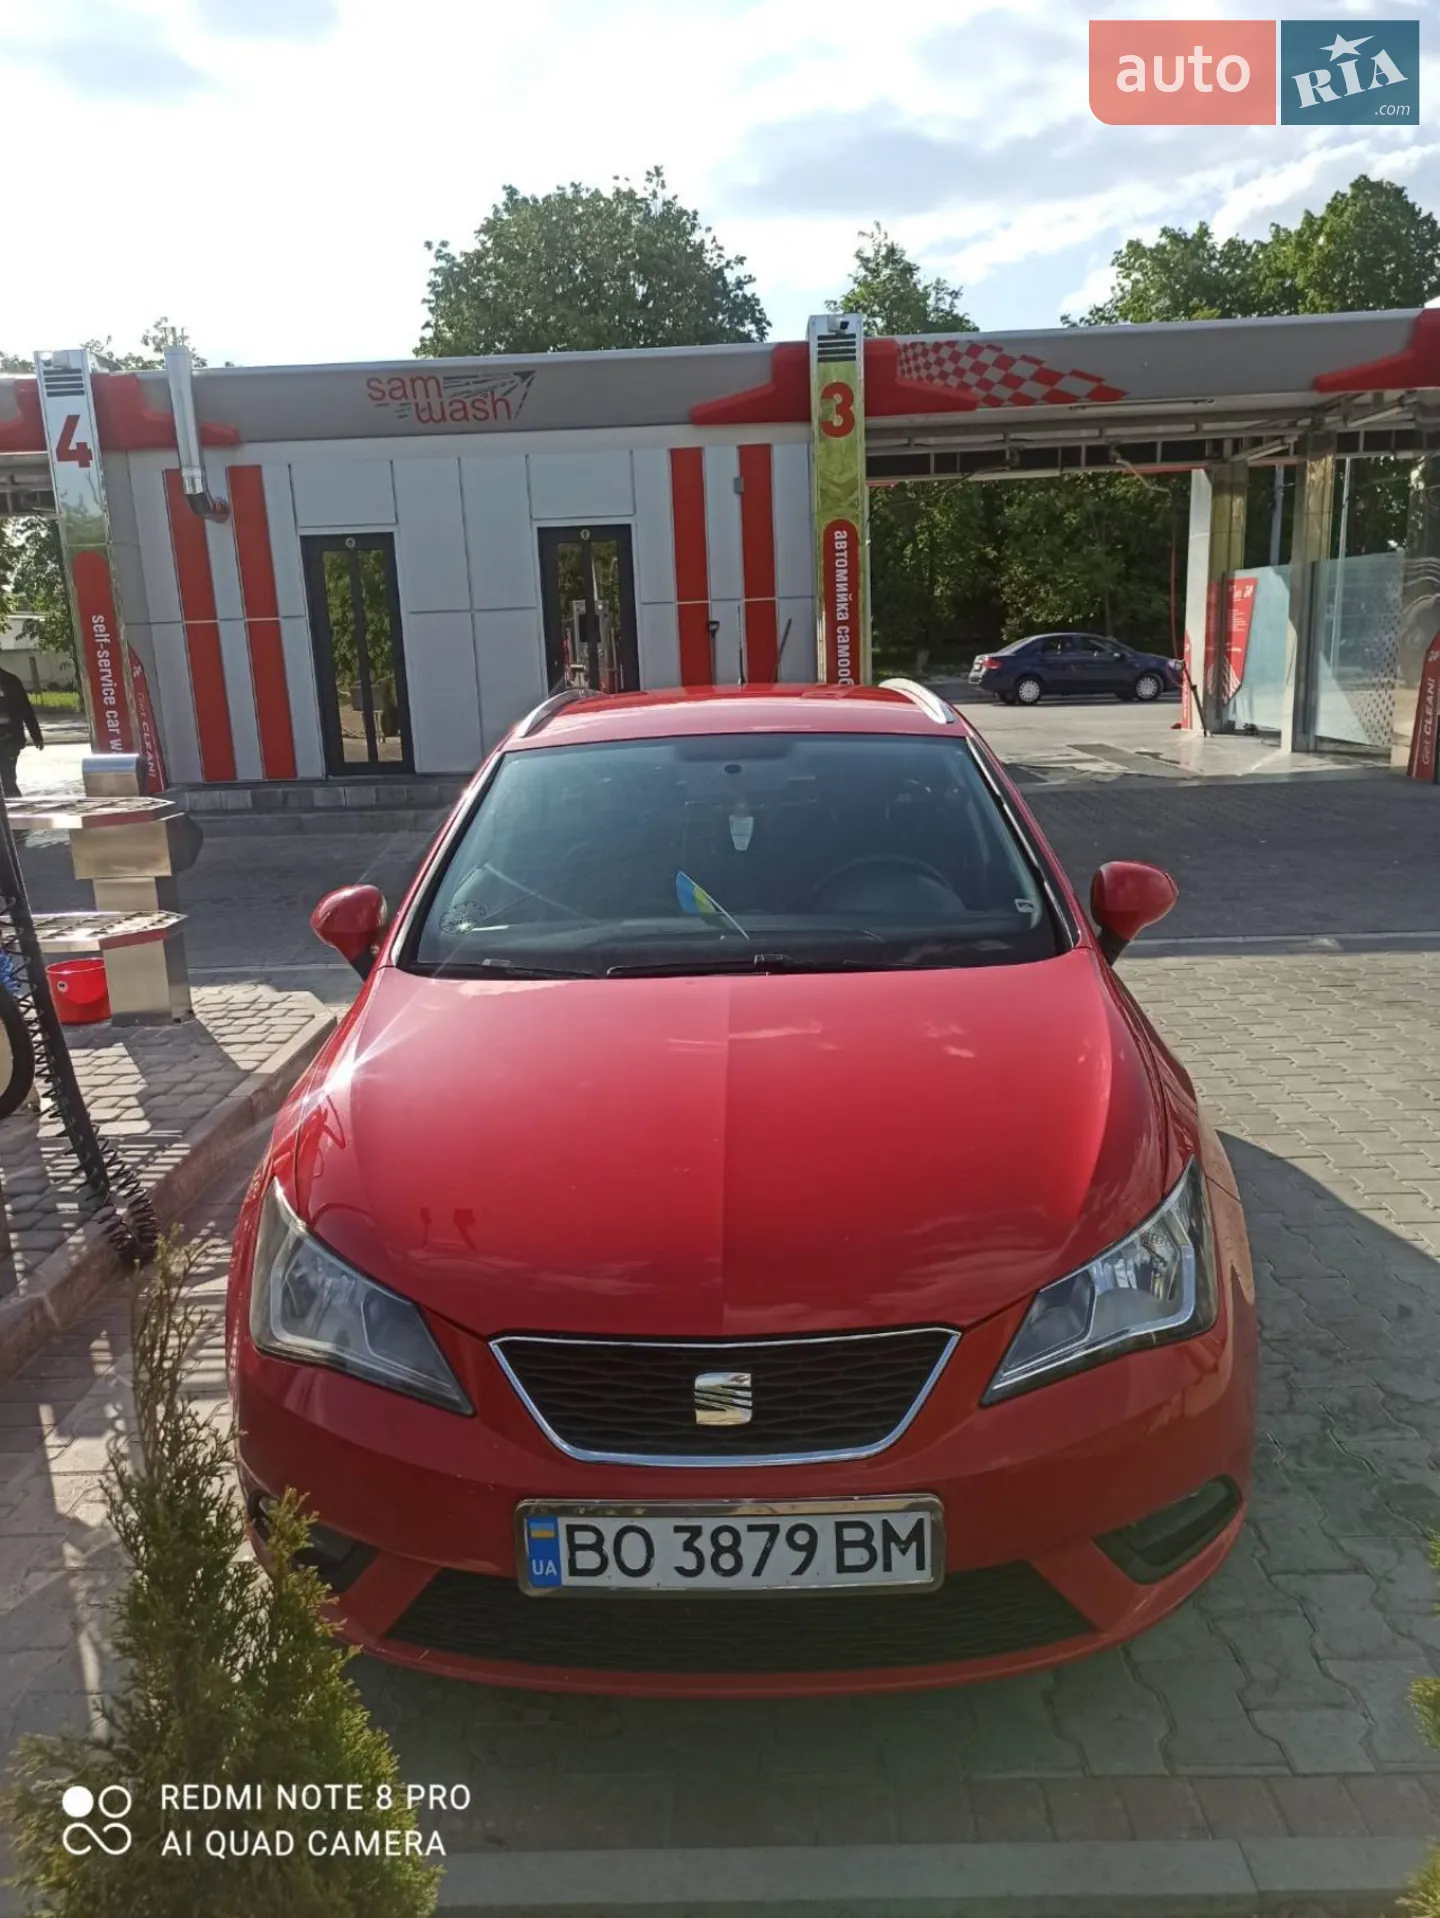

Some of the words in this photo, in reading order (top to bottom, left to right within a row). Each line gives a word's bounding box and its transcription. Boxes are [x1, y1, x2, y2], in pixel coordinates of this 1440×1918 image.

[366, 375, 443, 402] sam
[413, 390, 512, 424] wash
[820, 381, 855, 438] 3
[56, 414, 93, 468] 4
[834, 530, 853, 621] автомийка
[91, 614, 116, 706] self-service
[105, 710, 120, 736] car
[532, 1559, 557, 1576] UA
[565, 1523, 655, 1578] BO
[673, 1522, 819, 1578] 3879
[835, 1517, 926, 1575] BM
